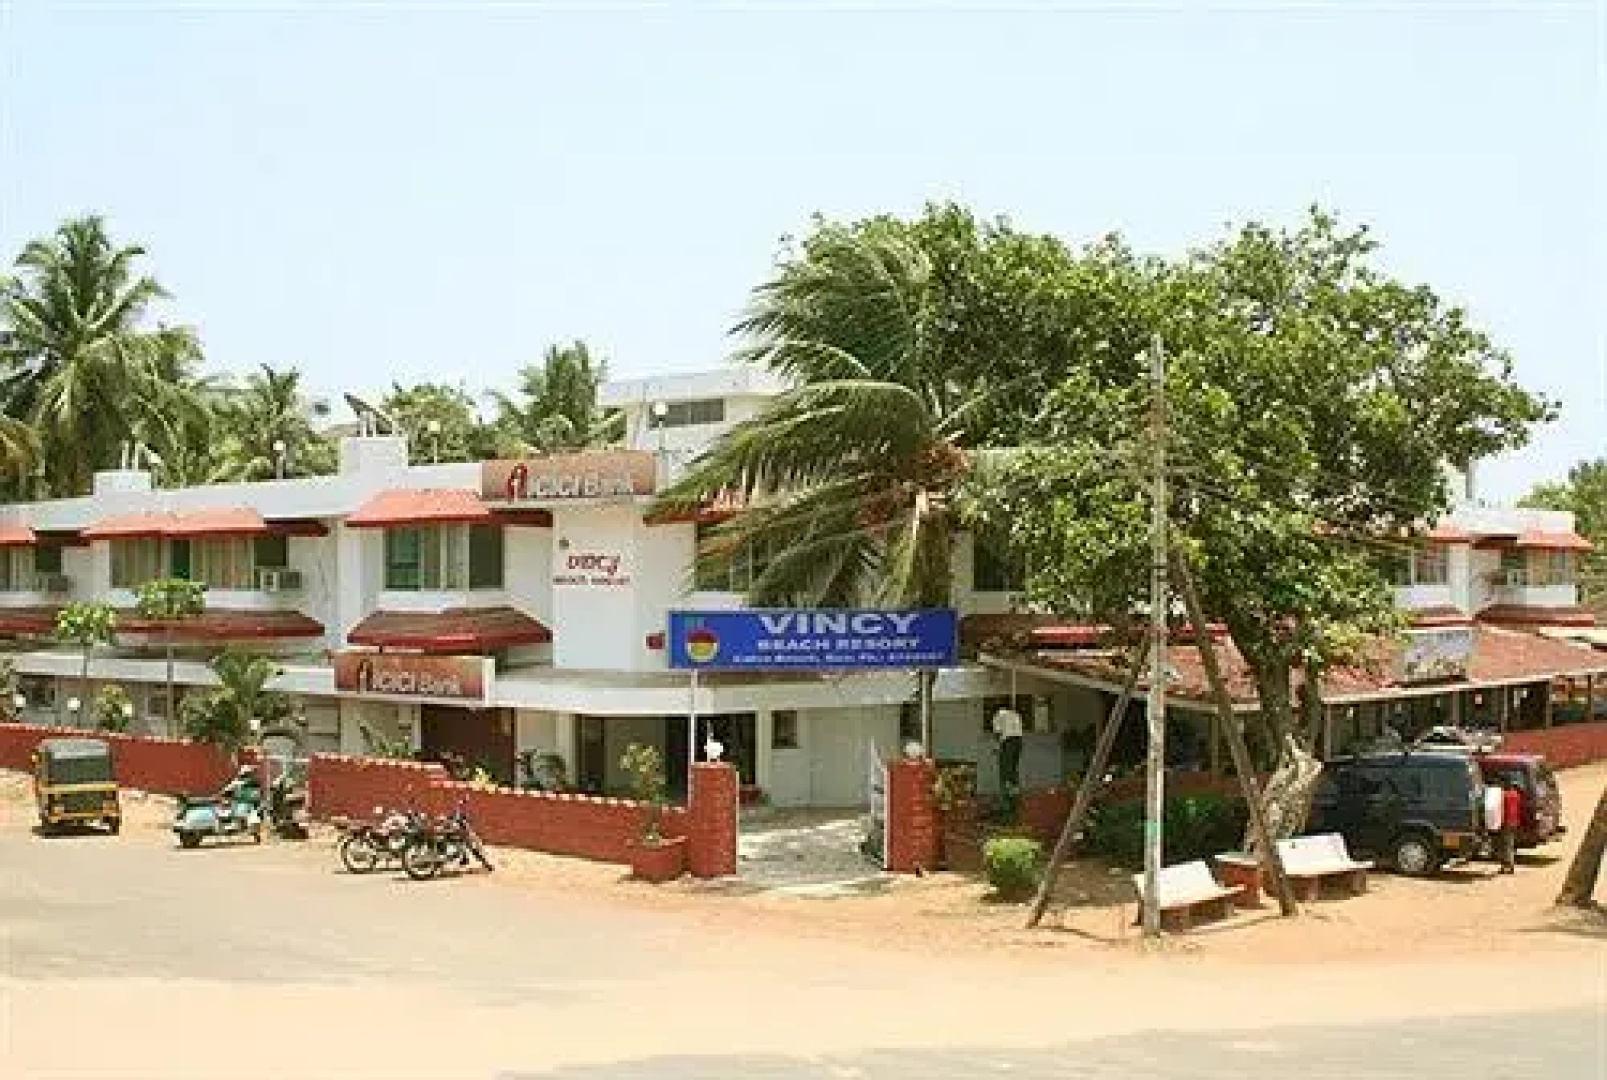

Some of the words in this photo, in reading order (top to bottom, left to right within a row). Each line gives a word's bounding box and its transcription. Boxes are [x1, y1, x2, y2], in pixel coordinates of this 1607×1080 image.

[759, 613, 919, 634] VINCY
[757, 638, 830, 650] BEACH
[836, 638, 919, 650] RESORT
